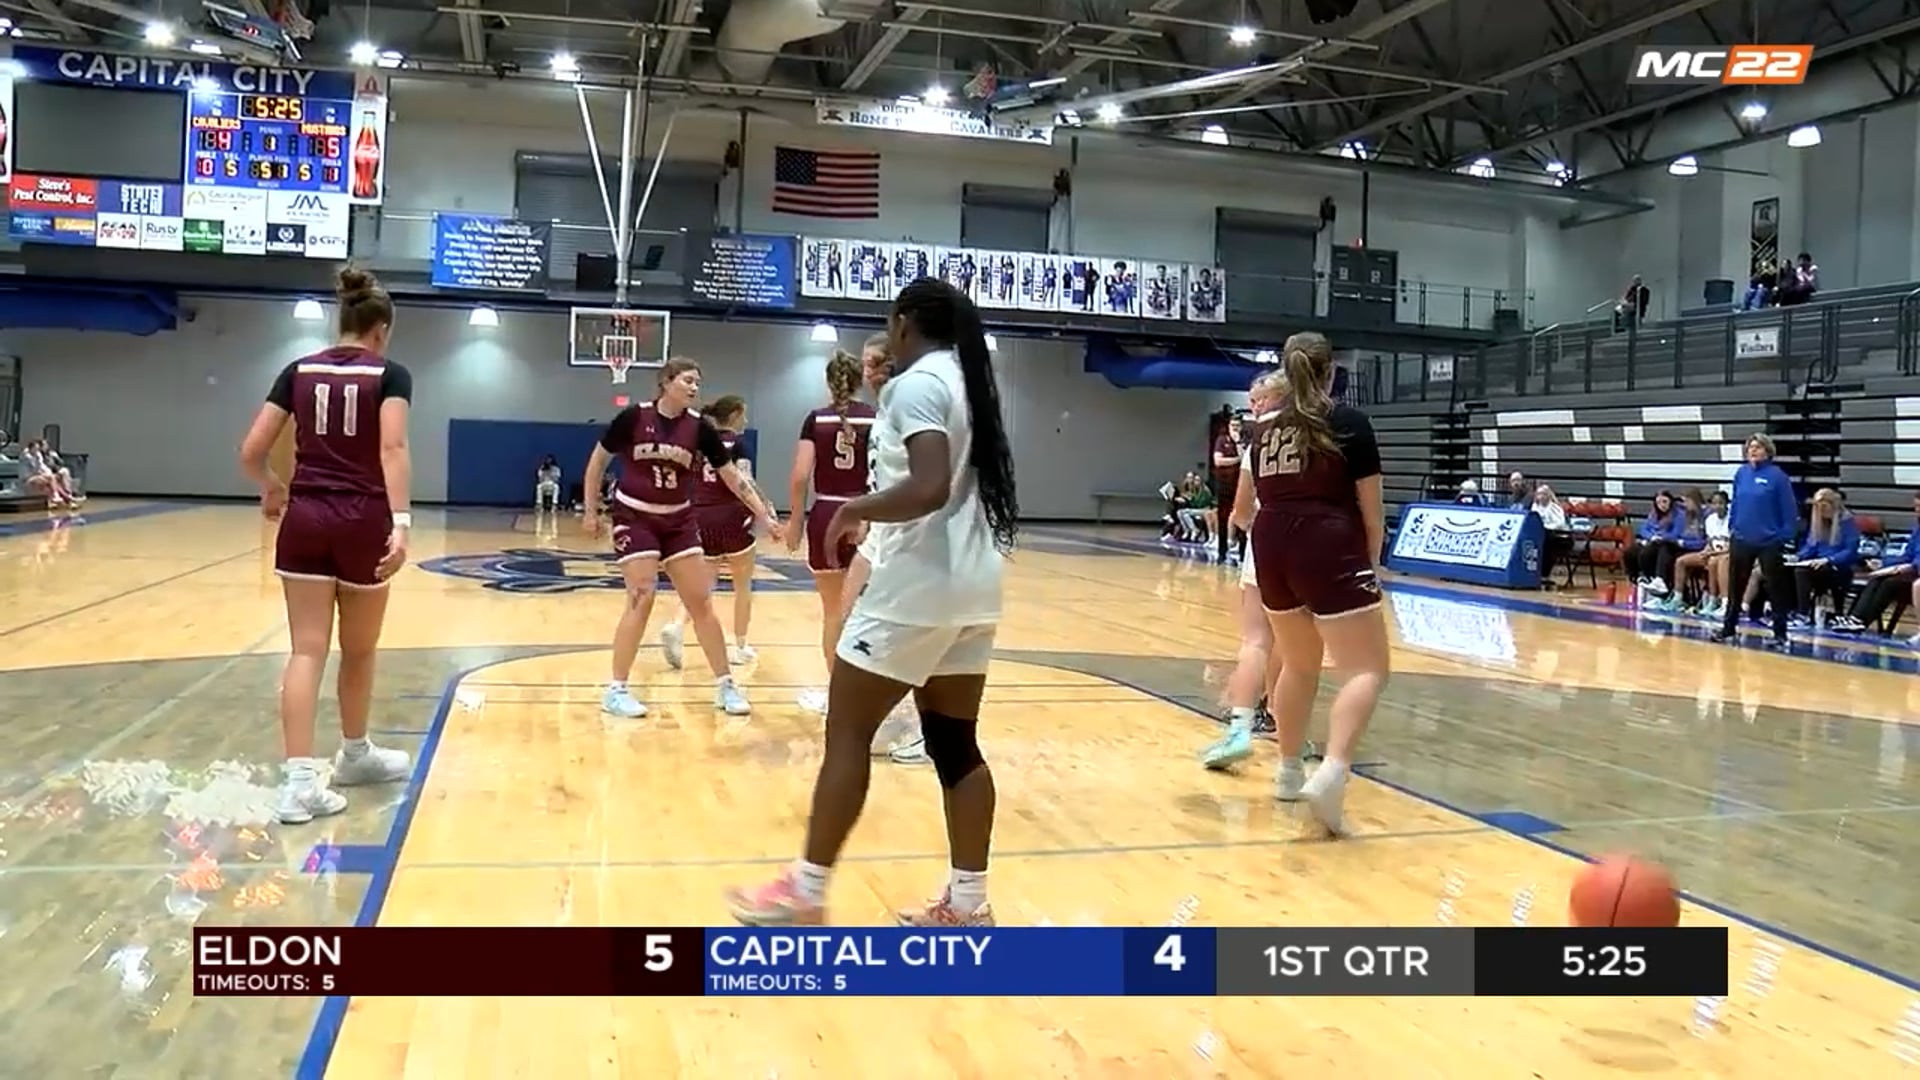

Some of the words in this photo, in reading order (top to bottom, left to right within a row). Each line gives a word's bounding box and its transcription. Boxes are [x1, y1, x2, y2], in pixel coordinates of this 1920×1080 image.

[58, 51, 212, 87] CAPITAL
[233, 66, 316, 96] CITY
[255, 97, 302, 120] 5:25
[328, 137, 341, 158] 5
[38, 178, 71, 191] Steve's
[14, 190, 34, 201] Pest
[36, 191, 74, 205] Control,
[76, 195, 95, 205] Inc.
[146, 222, 178, 234] Rusty
[313, 382, 359, 437] 11
[834, 430, 857, 470] 5
[1259, 426, 1301, 478] 22
[652, 465, 678, 489] 13
